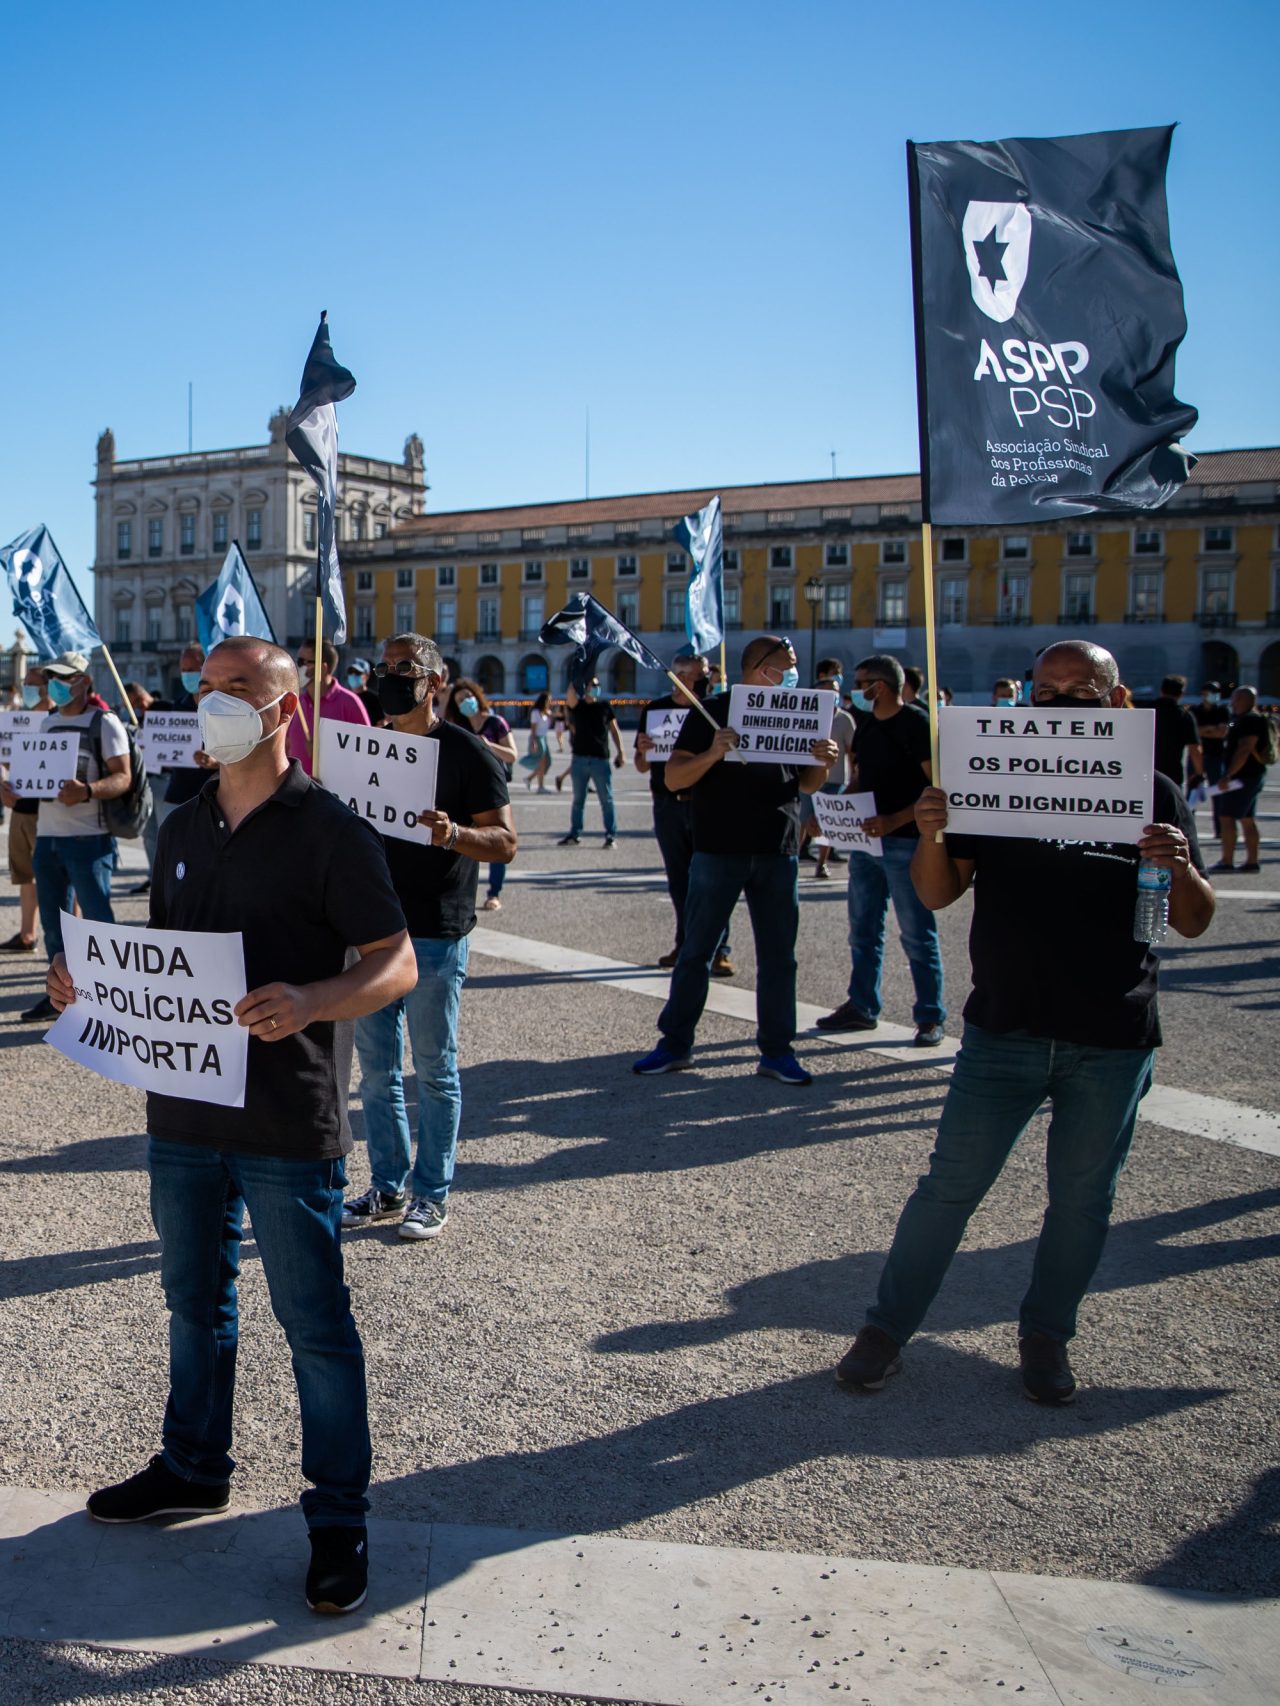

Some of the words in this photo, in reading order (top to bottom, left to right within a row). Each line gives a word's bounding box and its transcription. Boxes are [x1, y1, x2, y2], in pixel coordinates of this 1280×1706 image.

[974, 338, 1089, 384] ASPP
[1010, 385, 1096, 430] PSP
[986, 439, 1061, 456] Associação
[1064, 439, 1110, 458] Sindical
[991, 456, 1010, 470] dos
[1012, 456, 1093, 476] Profissionais
[991, 473, 1006, 487] da
[1009, 473, 1058, 487] Polícia
[747, 691, 764, 708] SÓ
[770, 692, 797, 711] NÃO
[800, 694, 819, 711] HÁ
[147, 716, 166, 726] NÃO
[663, 714, 672, 724] A
[742, 715, 790, 730] DINHEIRO
[792, 717, 818, 731] PARA
[977, 719, 1113, 736] TRATEM
[152, 732, 192, 742] POLÍCIAS
[756, 734, 816, 753] POLÍCIAS
[23, 741, 68, 751] VIDAS
[336, 732, 417, 764] VIDAS
[39, 760, 46, 769] A
[157, 752, 167, 760] de
[969, 757, 1000, 771] OS
[1009, 756, 1122, 775] POLÍCIAS
[15, 779, 65, 790] SALDO
[368, 772, 380, 787] A
[347, 797, 418, 828] ALDO
[822, 799, 856, 812] VIDA
[949, 793, 1000, 808] COM
[1009, 795, 1144, 815] DIGNIDADE
[819, 813, 863, 828] POLÍCIA
[823, 830, 871, 846] MPORTA
[87, 935, 105, 966] A
[110, 939, 194, 977] VIDA
[94, 981, 233, 1025] POLÍCIAS
[78, 1017, 222, 1076] IMPORTA
